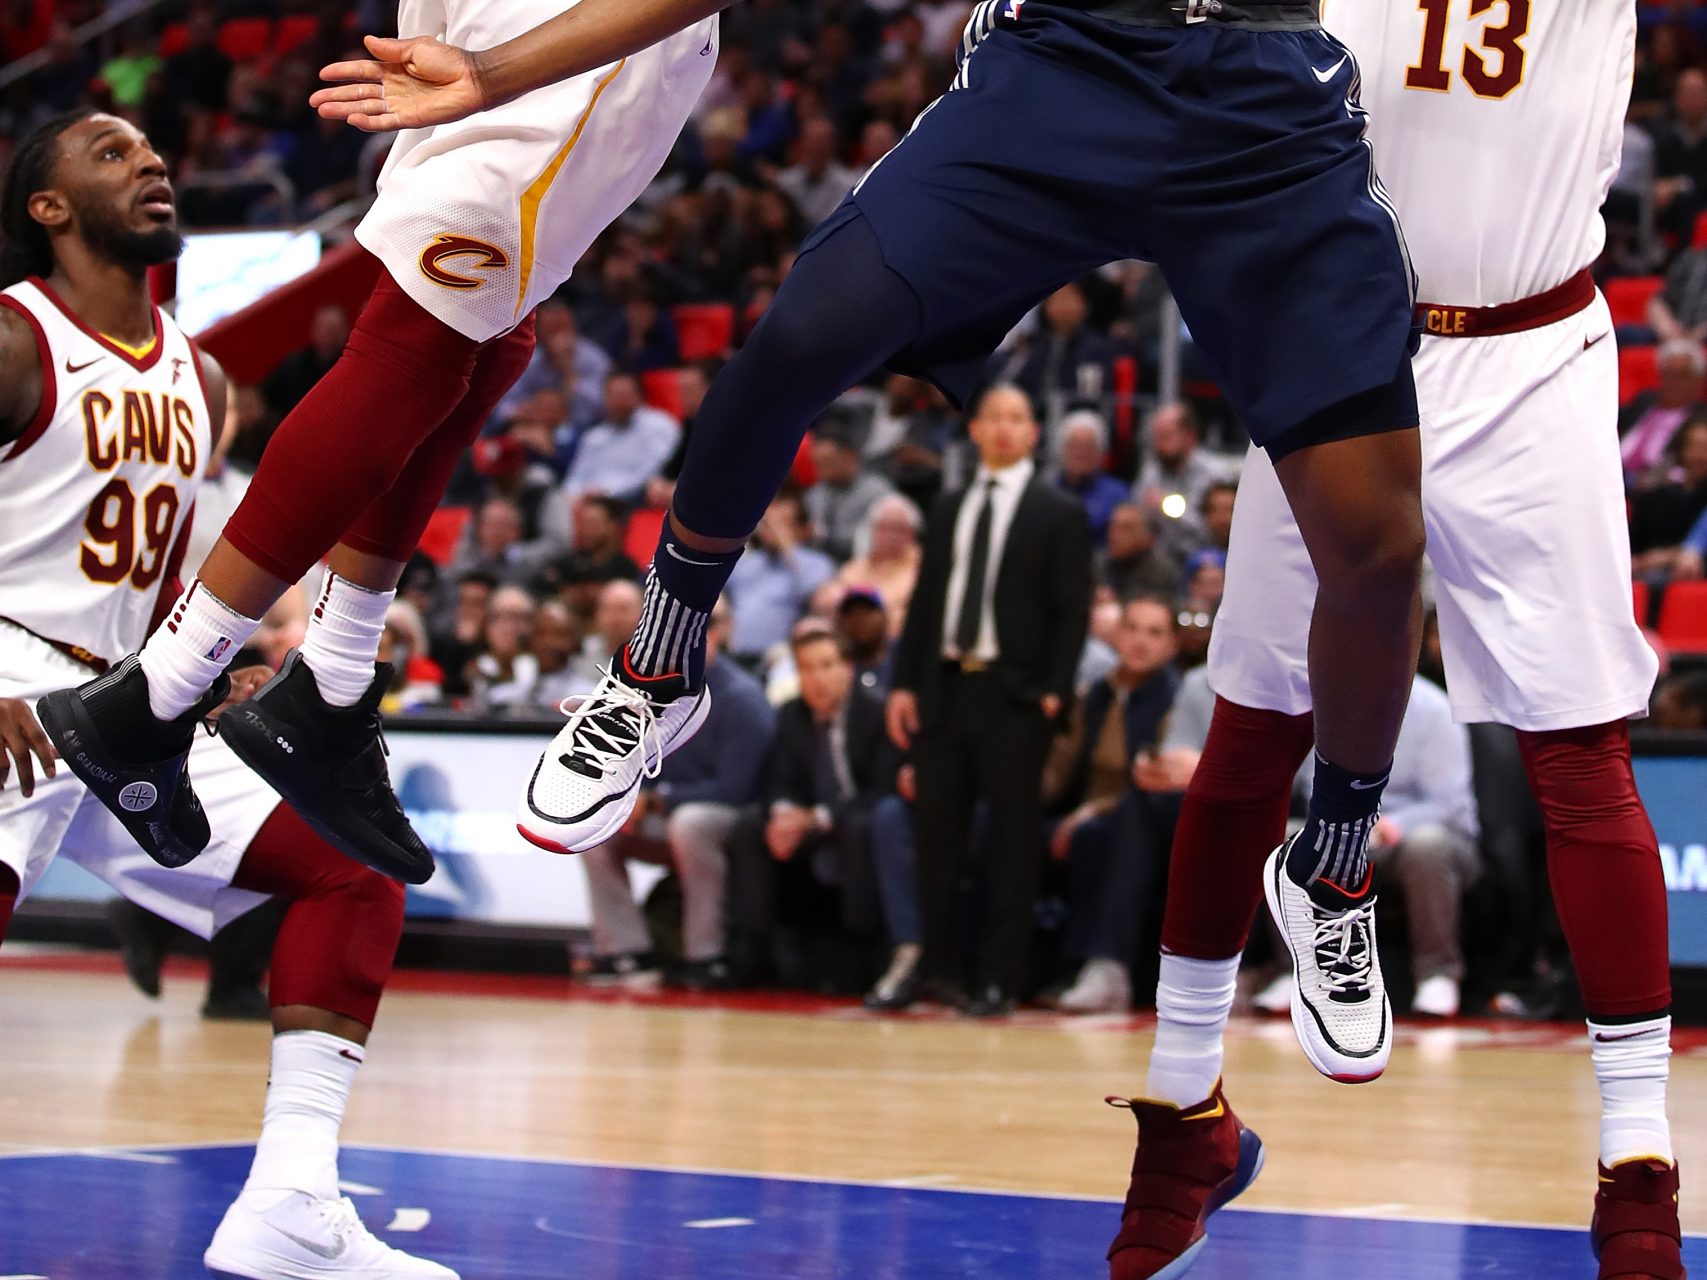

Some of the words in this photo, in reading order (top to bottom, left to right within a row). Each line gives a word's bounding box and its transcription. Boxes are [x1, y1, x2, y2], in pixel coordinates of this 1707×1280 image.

[1427, 309, 1467, 334] CLE
[79, 387, 198, 480] CAVS
[79, 477, 180, 592] 99
